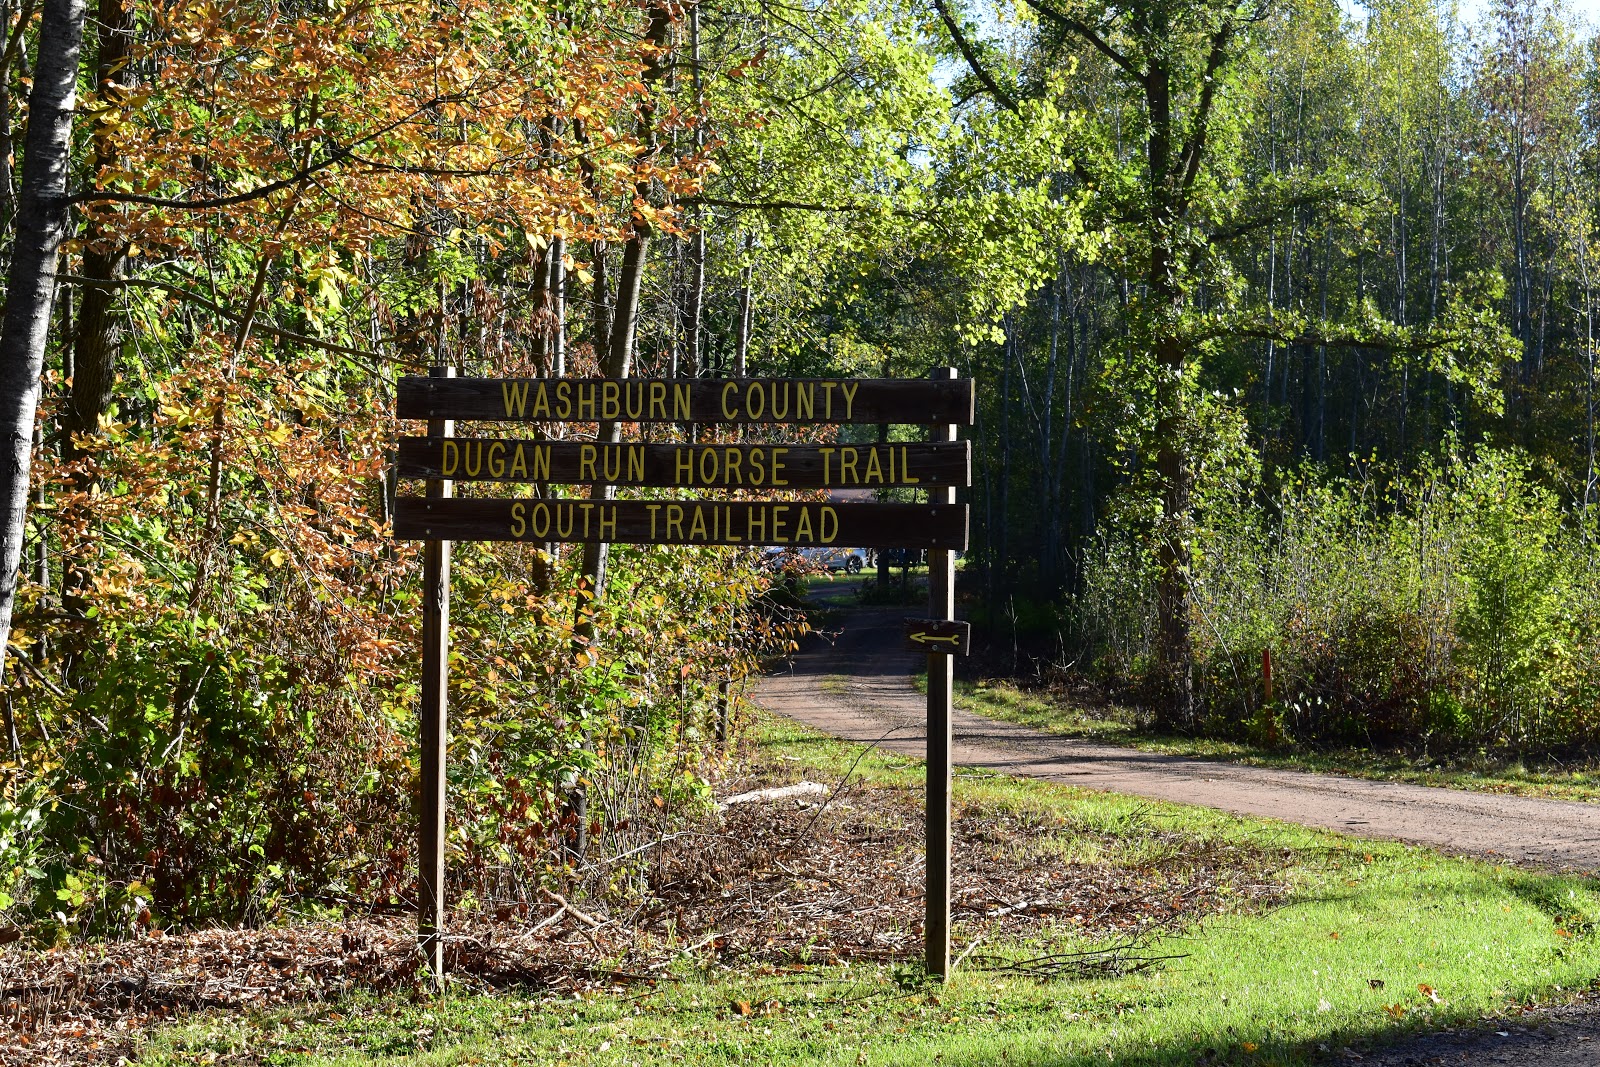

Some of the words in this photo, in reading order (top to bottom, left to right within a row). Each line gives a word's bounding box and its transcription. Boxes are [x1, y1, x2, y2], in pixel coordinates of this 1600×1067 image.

[502, 381, 692, 421] WASHBURN
[722, 381, 859, 420] COUNTY
[441, 440, 551, 480] DUGAN
[580, 444, 646, 482] RUN
[675, 446, 788, 486] HORSE
[818, 446, 920, 485] TRAIL
[509, 503, 618, 541] SOUTH
[646, 505, 840, 544] TRAILHEAD
